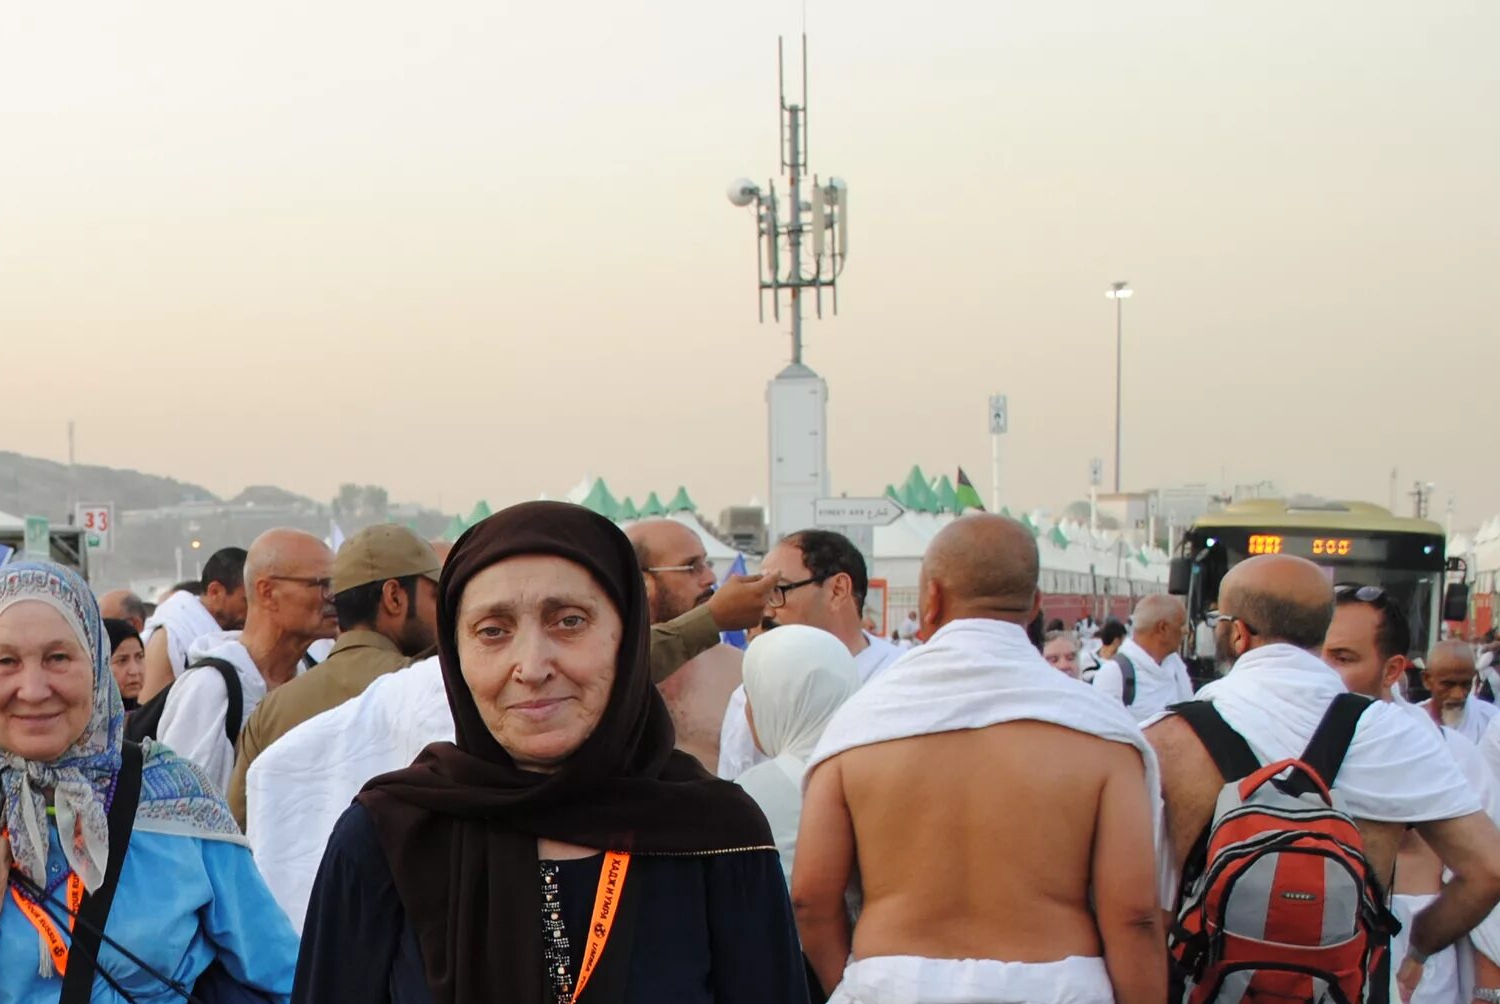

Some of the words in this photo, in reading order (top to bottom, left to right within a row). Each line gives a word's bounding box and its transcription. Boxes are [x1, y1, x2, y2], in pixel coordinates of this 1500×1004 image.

[608, 858, 621, 887] ХАДЖ
[605, 887, 614, 896] И
[600, 895, 613, 920] УМРА
[585, 942, 598, 972] UMMA
